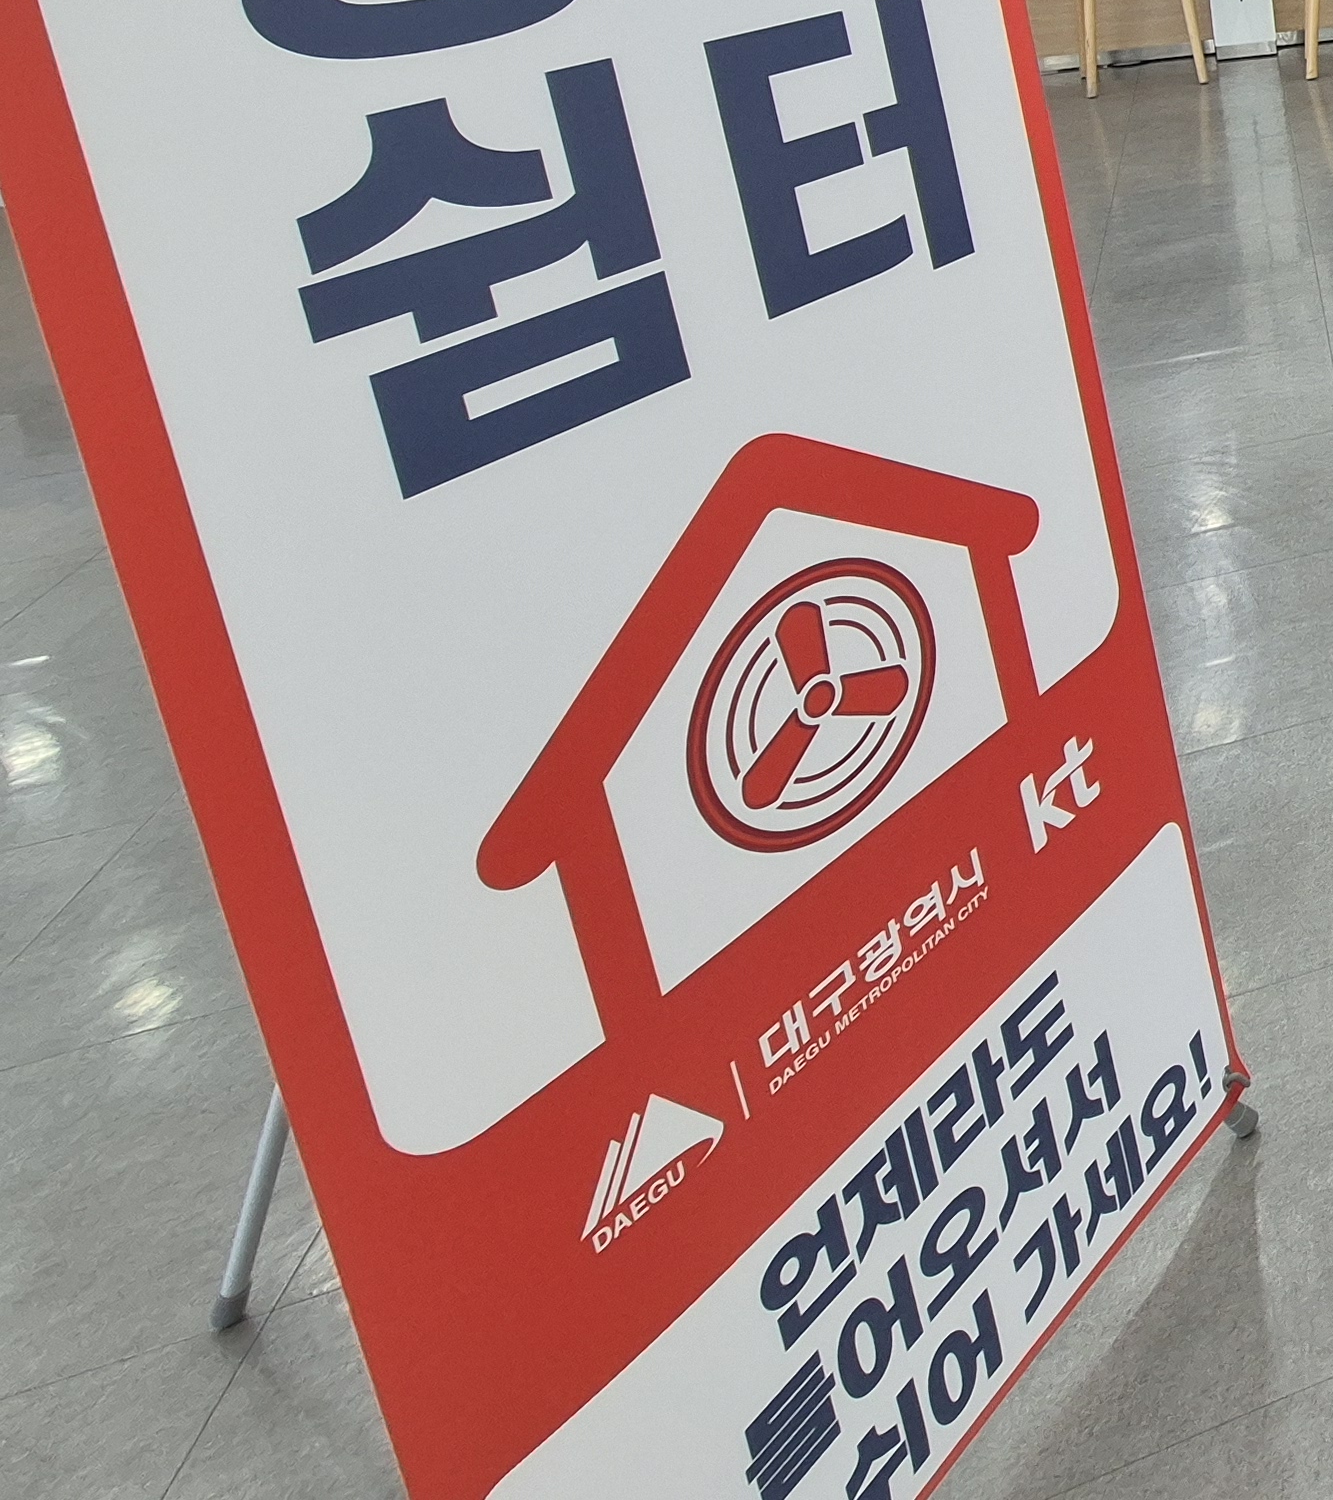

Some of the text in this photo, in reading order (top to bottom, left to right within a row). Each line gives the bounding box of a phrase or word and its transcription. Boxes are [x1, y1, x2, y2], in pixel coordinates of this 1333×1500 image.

[1018, 736, 1102, 854] kt
[757, 848, 985, 1068] 대구광역시
[768, 886, 990, 1095] DAEGU METROPOLITAN CITY
[592, 1160, 687, 1254] DAEGU
[743, 1030, 1123, 1500] 들어오셔서
[758, 969, 1076, 1352] 언제라도
[844, 1030, 1213, 1500] 쉬어 가세요!
